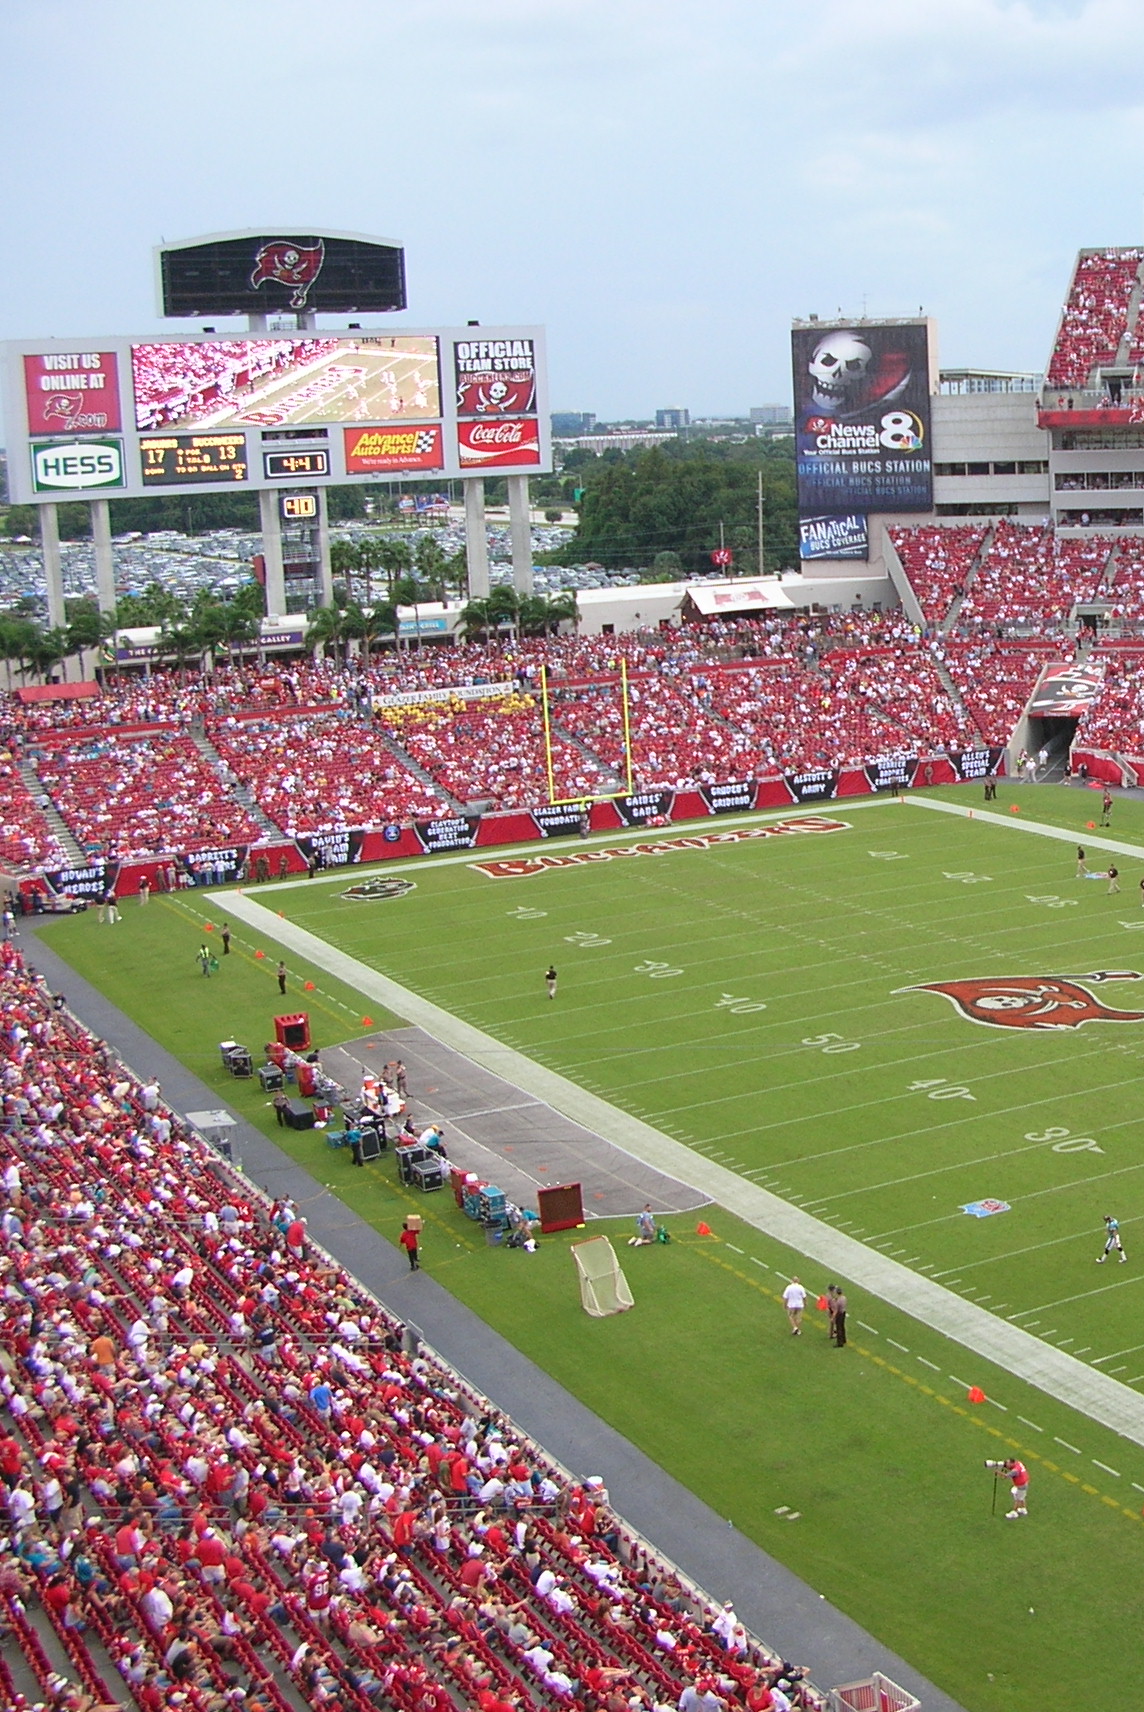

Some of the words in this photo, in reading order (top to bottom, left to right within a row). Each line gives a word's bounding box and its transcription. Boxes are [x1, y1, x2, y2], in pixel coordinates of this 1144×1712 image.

[458, 340, 532, 358] OFFICIAL
[43, 355, 79, 370] VISIT
[82, 354, 100, 369] US
[458, 359, 492, 371] TEAM
[494, 358, 532, 370] STORE
[42, 376, 88, 391] ONLINE
[90, 374, 106, 389] AT
[470, 424, 524, 444] Coca-Cola
[816, 433, 880, 448] Channel
[880, 411, 916, 449] 8
[831, 424, 876, 436] News
[360, 432, 414, 445] Advance
[148, 450, 165, 464] 17
[219, 447, 236, 460] 13
[352, 445, 380, 456] Auto
[382, 444, 413, 455] Parts
[43, 456, 113, 477] HESS
[283, 455, 323, 472] 4:41
[798, 460, 848, 474] OFFICIAL
[852, 461, 881, 474] BUCS
[886, 460, 930, 473] STATION
[234, 470, 244, 480] 2
[850, 476, 872, 486] BUCS
[876, 476, 911, 485] STATION
[876, 486, 896, 494] BUCS
[898, 486, 926, 494] STATION
[286, 498, 314, 516] 40
[801, 516, 859, 543] FANATICAL
[810, 538, 830, 550] BUCS
[832, 533, 866, 547] COVERAGE
[260, 634, 291, 644] GALLEY
[383, 694, 418, 706] GLAZER
[418, 691, 446, 702] FAMILY
[961, 760, 990, 770] SPECIAL
[965, 768, 986, 778] TEAM
[802, 784, 826, 795] ARMY
[311, 834, 350, 848] DAVID'S
[466, 816, 853, 880] BUCCANEERS
[506, 906, 548, 920] 10
[564, 931, 612, 948] 20
[634, 960, 684, 979] 30
[714, 993, 767, 1014] 40
[801, 1032, 862, 1054] 50
[907, 1078, 974, 1101] 40
[1024, 1126, 1099, 1154] 30
[314, 1581, 330, 1597] 90
[423, 1692, 436, 1708] 40
